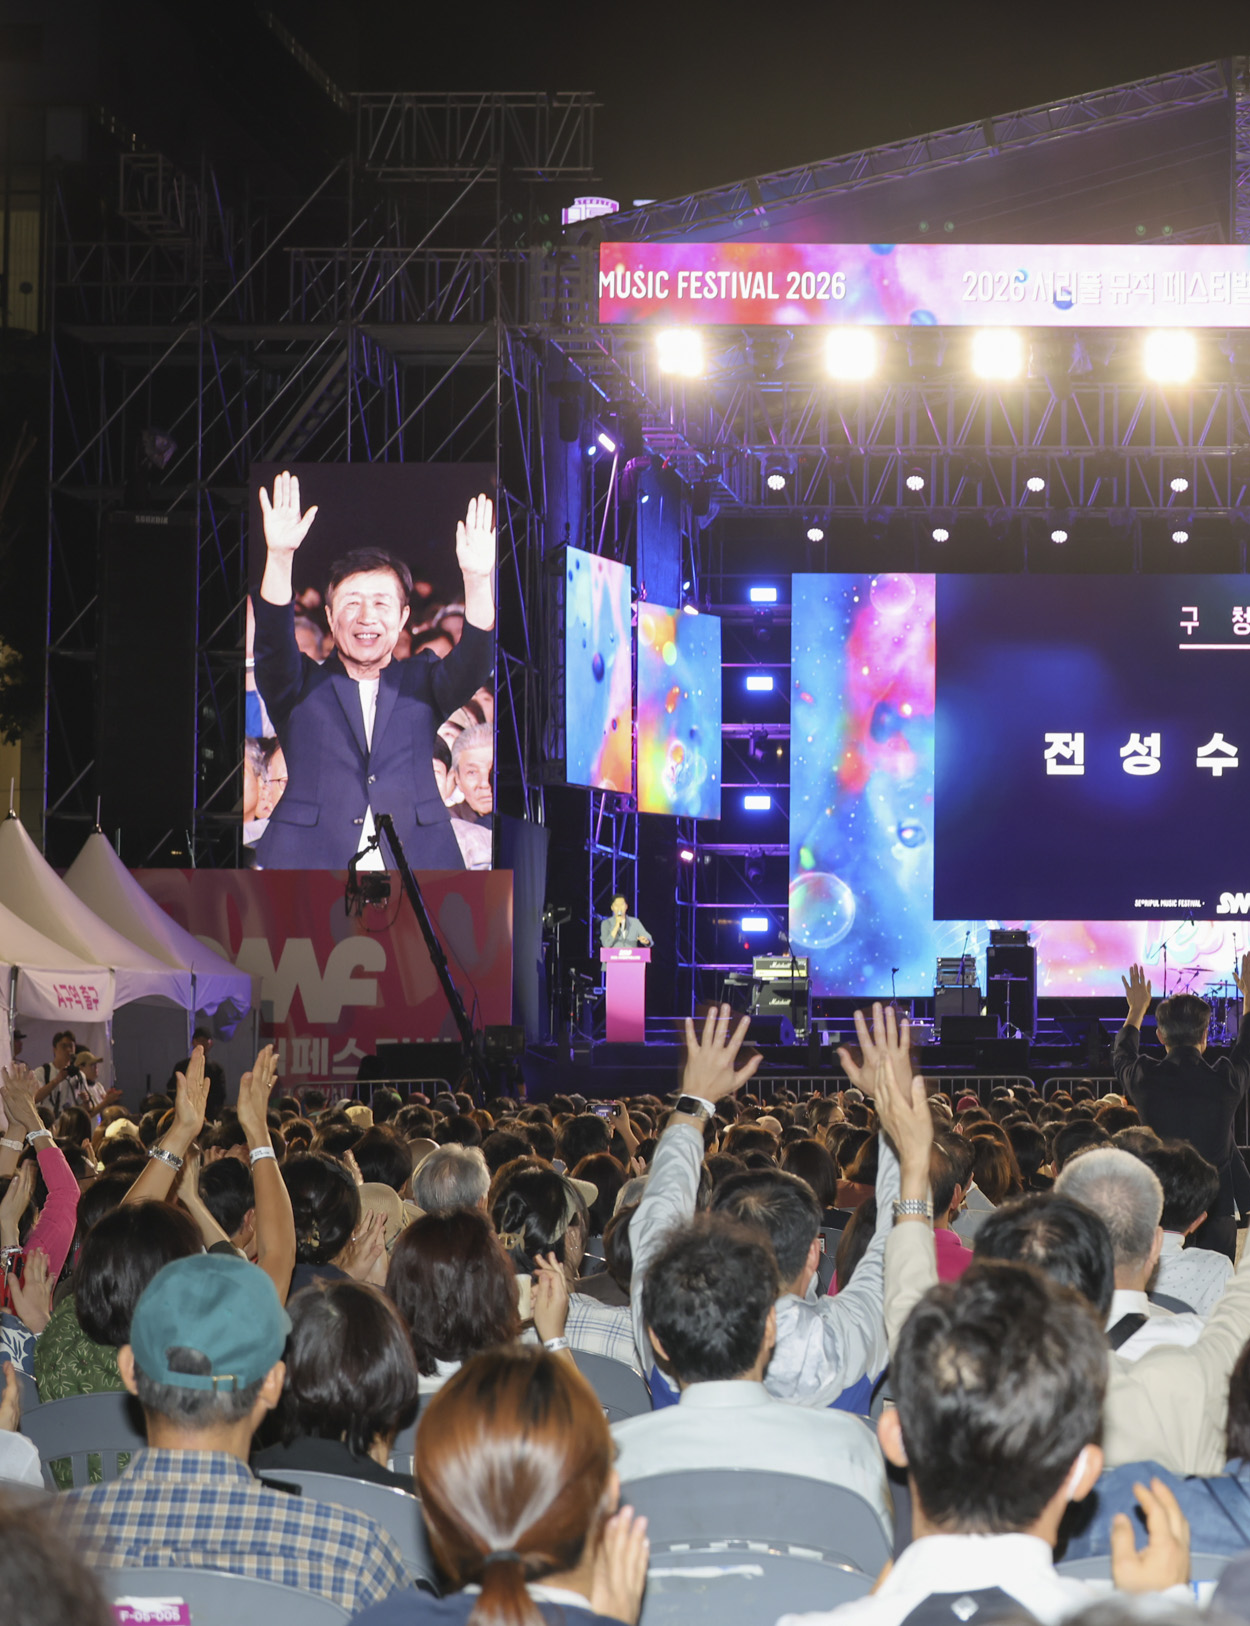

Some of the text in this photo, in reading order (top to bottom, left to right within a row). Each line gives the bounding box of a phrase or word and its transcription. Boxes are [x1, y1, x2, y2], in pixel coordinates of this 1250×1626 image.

[598, 270, 846, 300] MUSIC FESTIVAL 2026
[962, 270, 1026, 302] 2026
[1032, 271, 1102, 304] 서리풀
[1108, 271, 1156, 304] 뮤직
